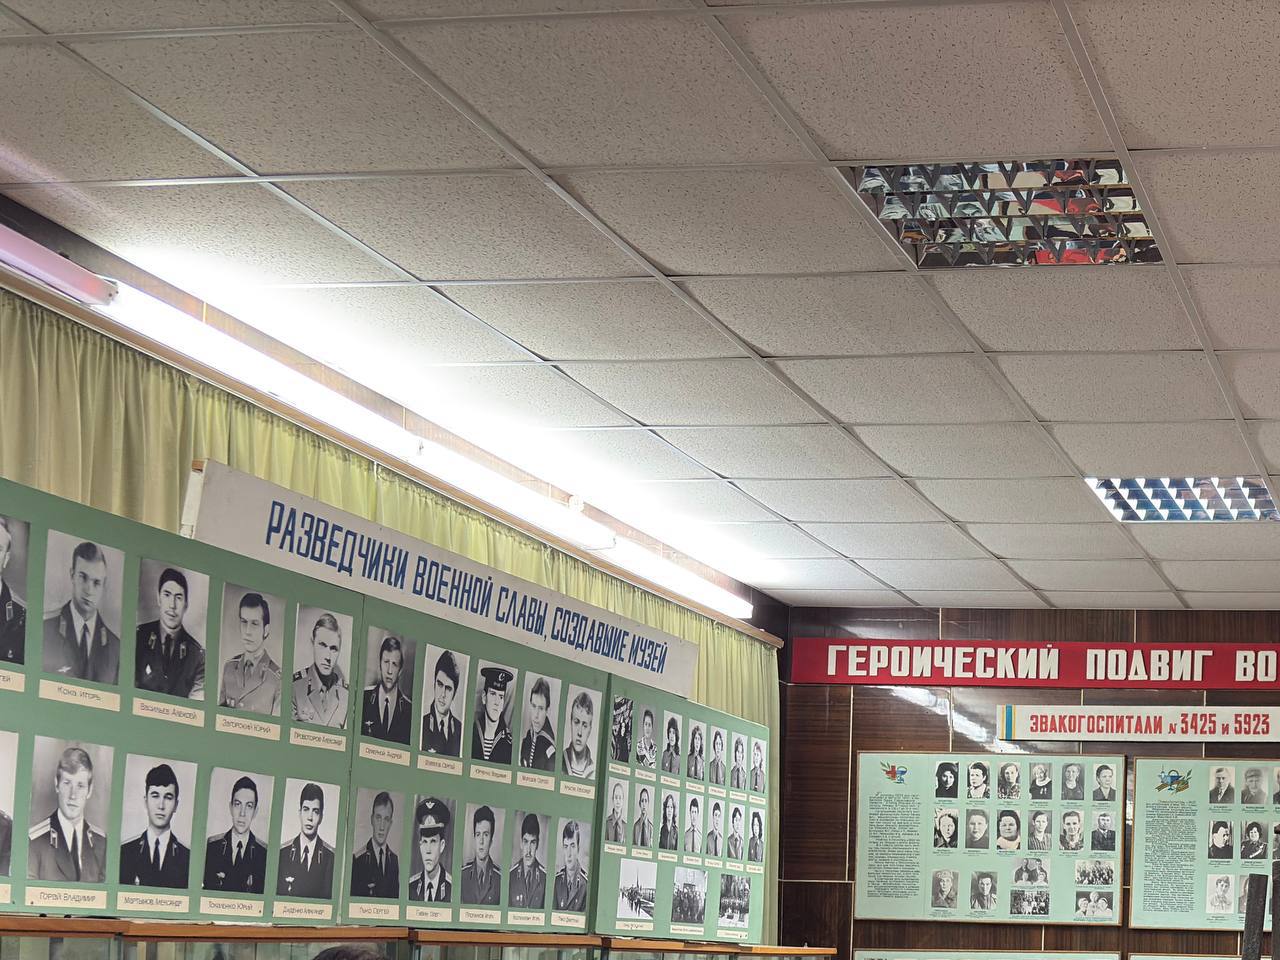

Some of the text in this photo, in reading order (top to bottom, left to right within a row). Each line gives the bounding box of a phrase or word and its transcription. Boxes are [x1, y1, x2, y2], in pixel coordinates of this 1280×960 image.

[266, 500, 668, 674] РАЗВЕДЧИКИ ВОЕННОЙ СЛАВЫ, СОЗДАВШИЕ МУЗЕЙ
[827, 644, 1060, 681] ГЕРОИЧЕСКИЙ
[1086, 648, 1214, 682] ПОДВИГ
[1234, 650, 1278, 683] ВО
[1029, 714, 1163, 735] ЭВАКОГОСПИТАЛИ
[1180, 713, 1217, 735] 3425
[1234, 713, 1270, 735] 5923
